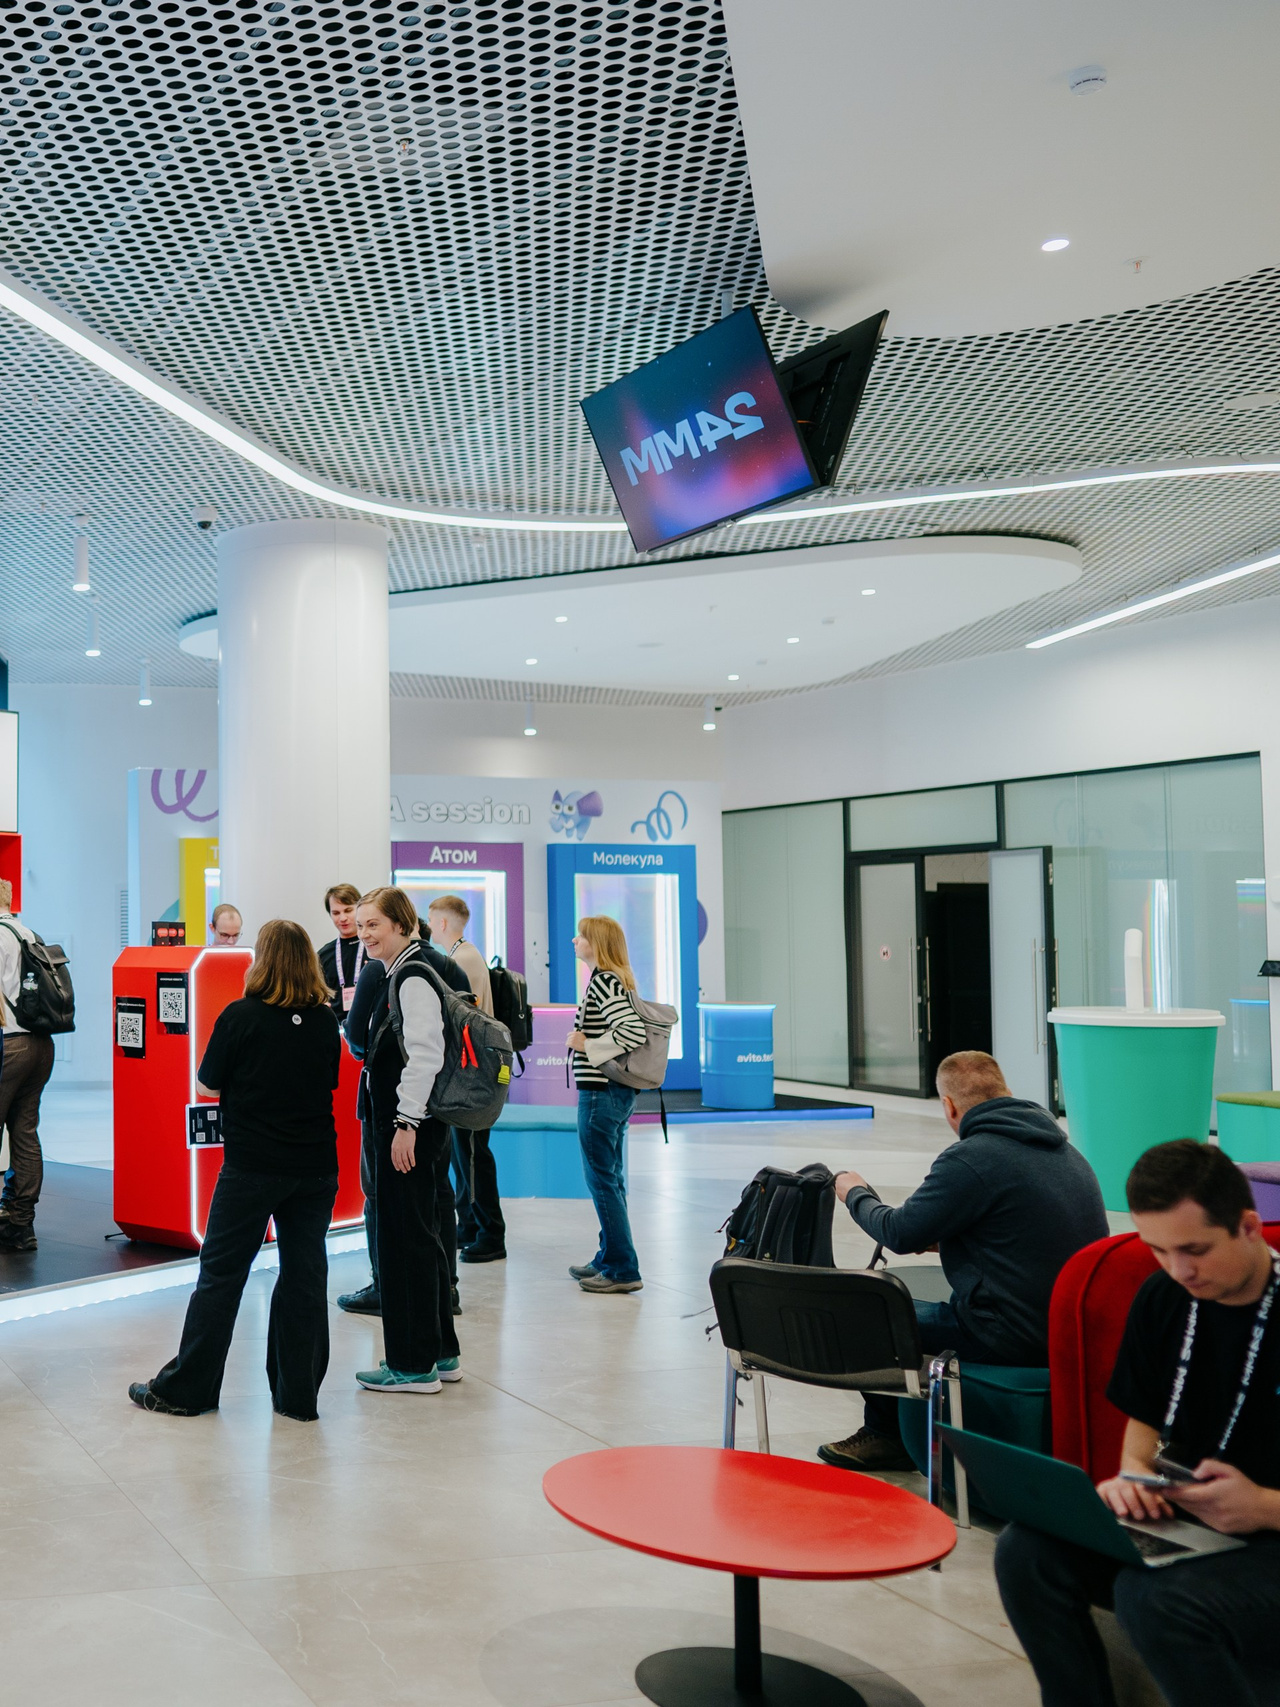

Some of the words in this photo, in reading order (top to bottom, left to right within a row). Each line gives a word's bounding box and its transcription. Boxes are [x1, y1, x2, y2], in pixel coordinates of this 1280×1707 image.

[411, 796, 531, 826] session
[429, 845, 478, 864] Атом
[592, 851, 665, 869] Молекула
